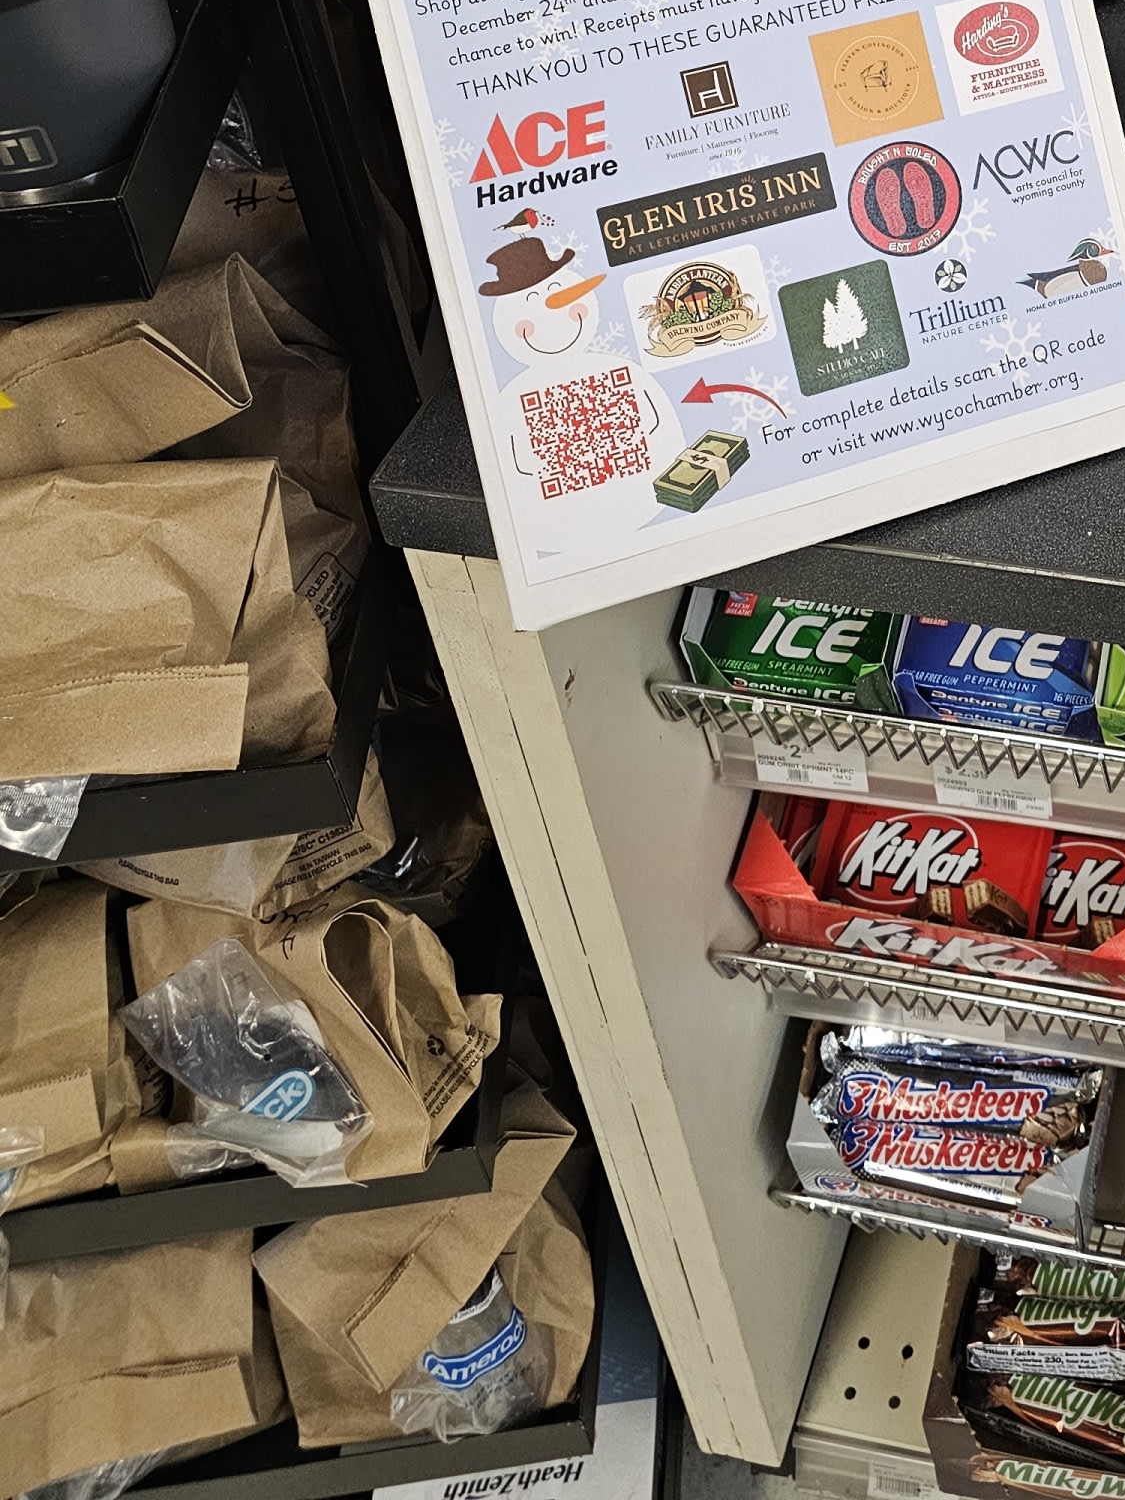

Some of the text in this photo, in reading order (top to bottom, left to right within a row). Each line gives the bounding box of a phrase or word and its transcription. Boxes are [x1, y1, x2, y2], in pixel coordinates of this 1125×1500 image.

[441, 7, 536, 40] December
[448, 42, 513, 67] chance
[515, 36, 535, 52] to
[539, 20, 579, 46] win!
[582, 9, 656, 36] Receipts
[455, 64, 539, 101] THANK
[538, 53, 588, 82] YOU
[591, 46, 625, 69] TO
[627, 27, 702, 61] THESE
[469, 100, 606, 184] ACE
[476, 159, 619, 208] Hardware
[602, 167, 823, 249] GLEN IRIS INN
[909, 296, 1007, 334] Trillium
[921, 313, 1009, 345] NATURE CENTER
[761, 328, 1107, 446] For complete details scan the QR code
[801, 370, 1084, 465] or visit www.wycochamber.org.
[751, 610, 868, 664] ICE
[949, 623, 1066, 680] ICE
[767, 660, 834, 676] SPEARMINT
[963, 674, 1038, 693] PEPPERMINT
[838, 820, 980, 895] KitKat
[839, 1076, 1046, 1121] 3 Musketeers
